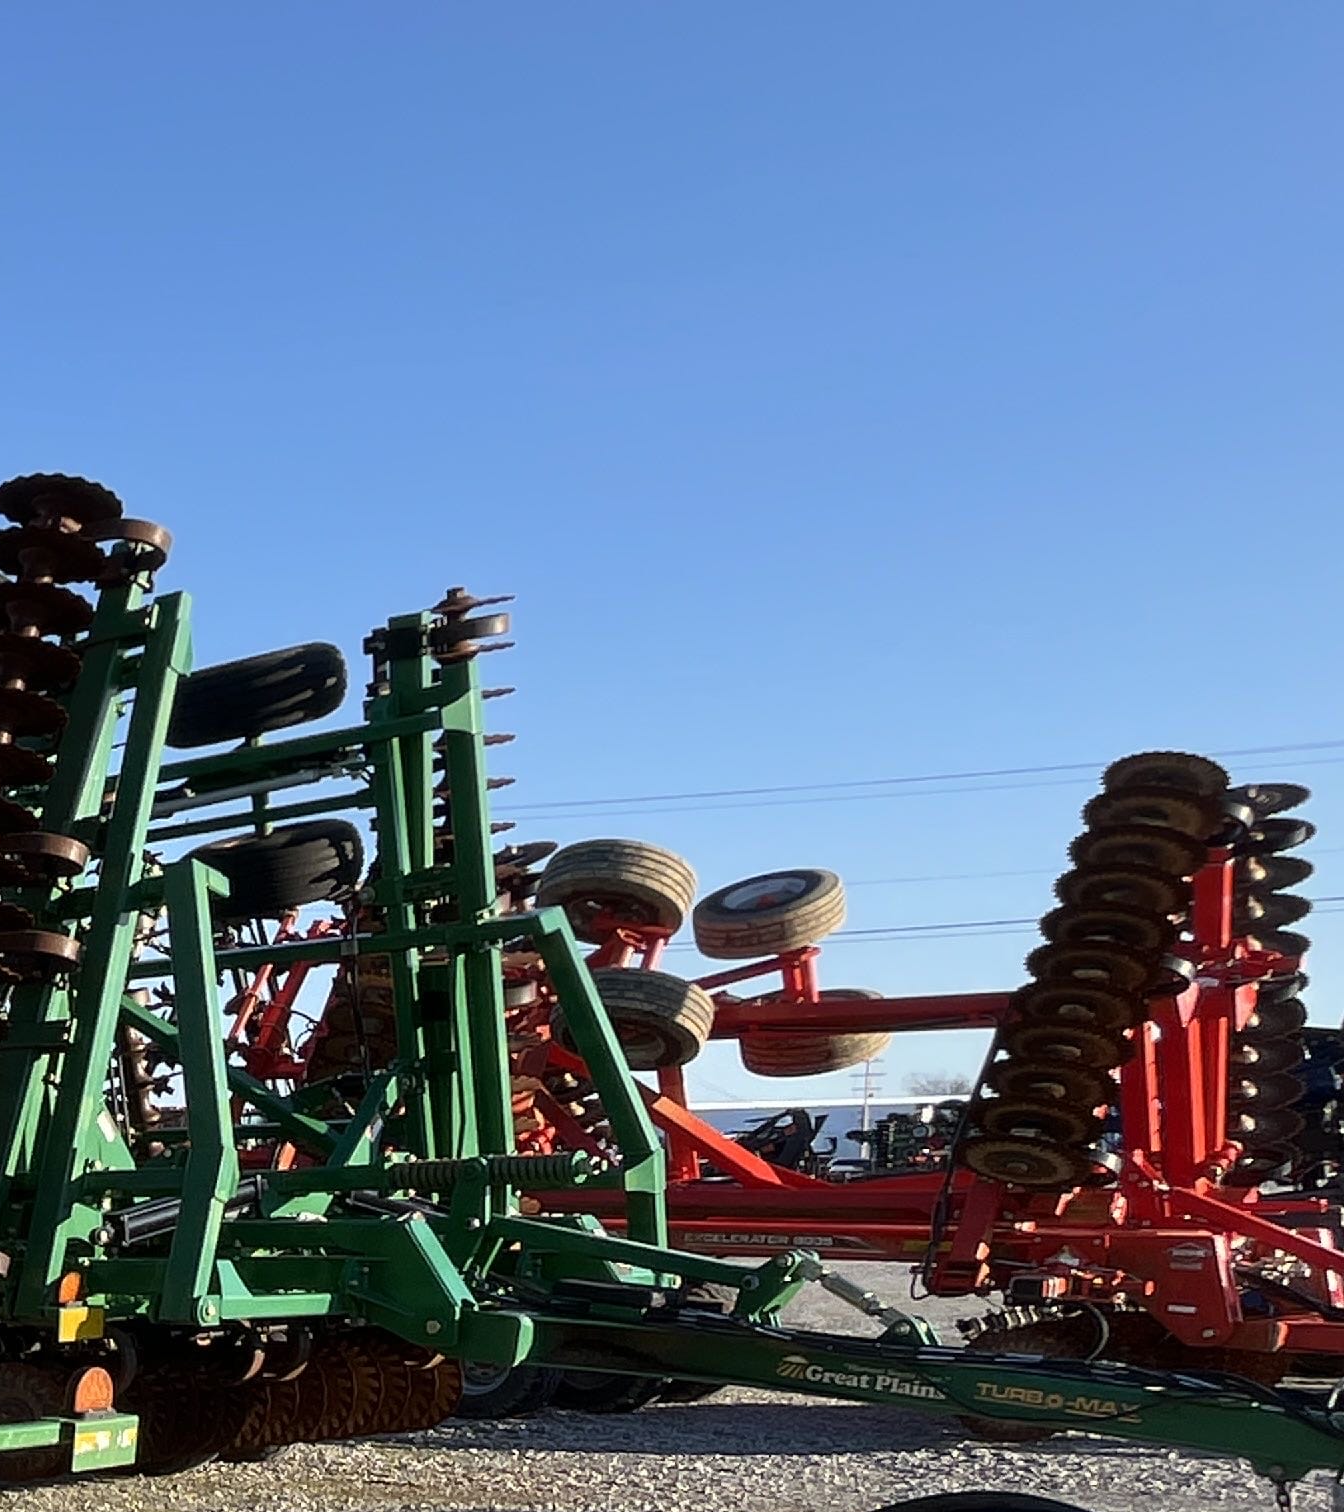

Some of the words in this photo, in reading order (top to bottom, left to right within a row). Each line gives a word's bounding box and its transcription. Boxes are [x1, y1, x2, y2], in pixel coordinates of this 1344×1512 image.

[684, 1232, 789, 1245] EXCELERATOR
[806, 1365, 870, 1389] Great
[874, 1374, 947, 1400] Plains
